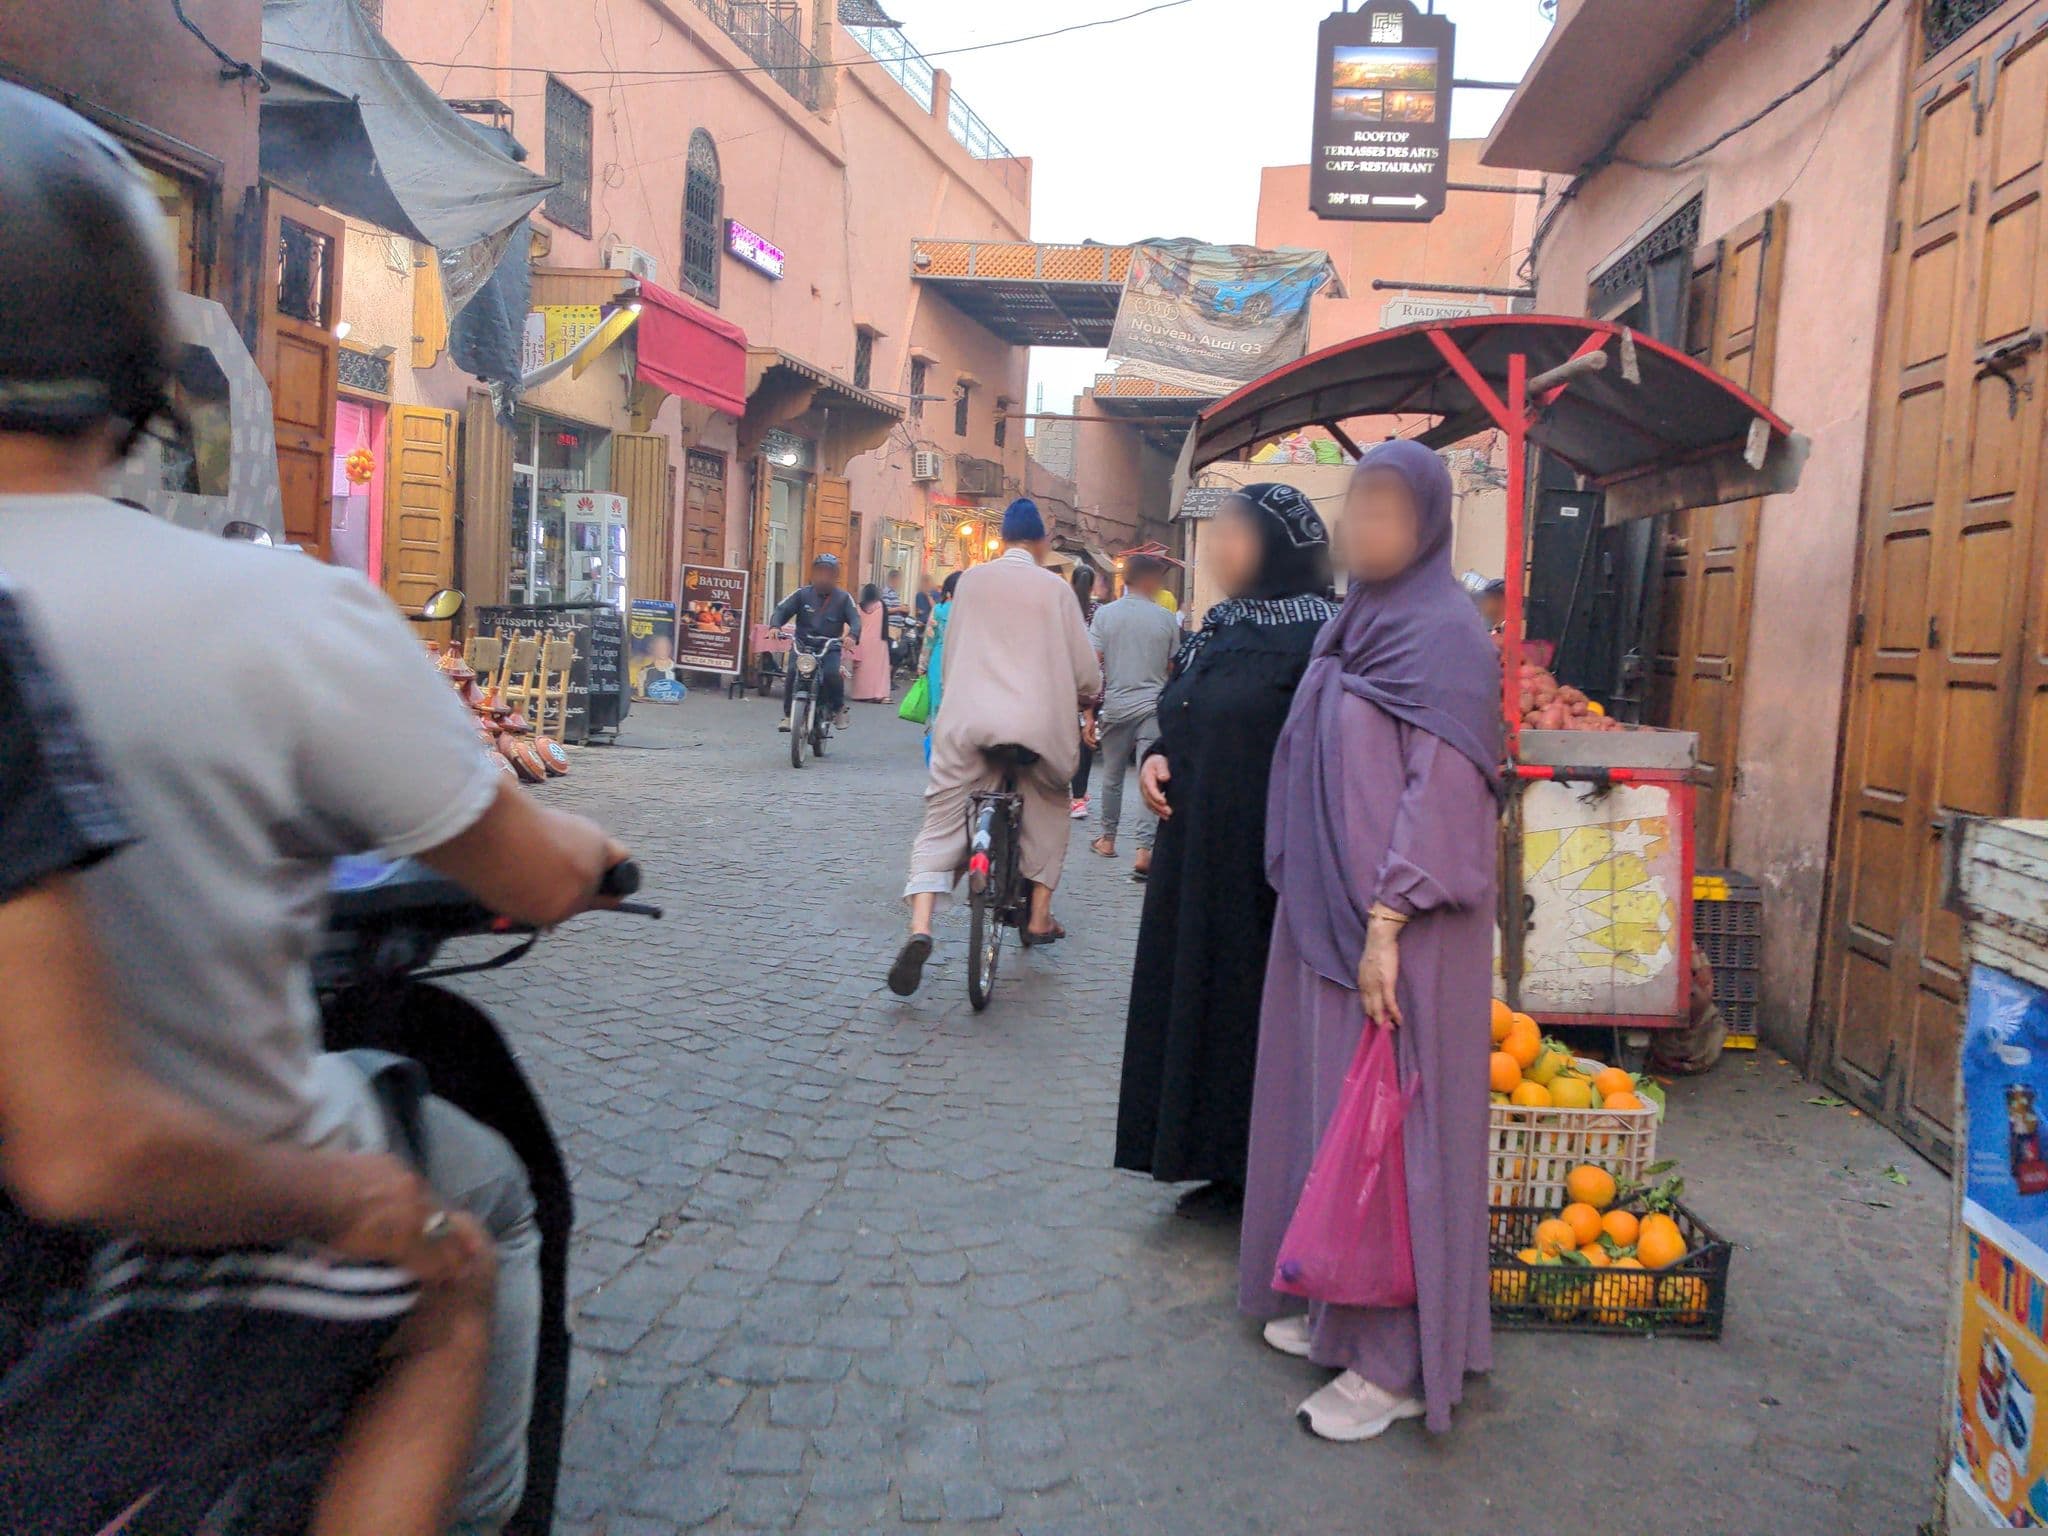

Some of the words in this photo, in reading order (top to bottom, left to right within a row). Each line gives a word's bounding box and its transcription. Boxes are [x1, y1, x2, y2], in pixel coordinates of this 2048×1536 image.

[1353, 131, 1410, 142] ROOFTOP
[1323, 145, 1385, 157] TERRASSES
[1386, 147, 1408, 158] DES
[1409, 148, 1439, 159] ARTS
[1402, 304, 1434, 318] RIAD
[1436, 307, 1472, 319] KNIZA
[1131, 318, 1195, 343] Nouveau
[1199, 334, 1236, 351] Audi
[1240, 341, 1262, 355] Q3
[699, 576, 743, 590] BATOUL
[711, 590, 731, 600] SPA
